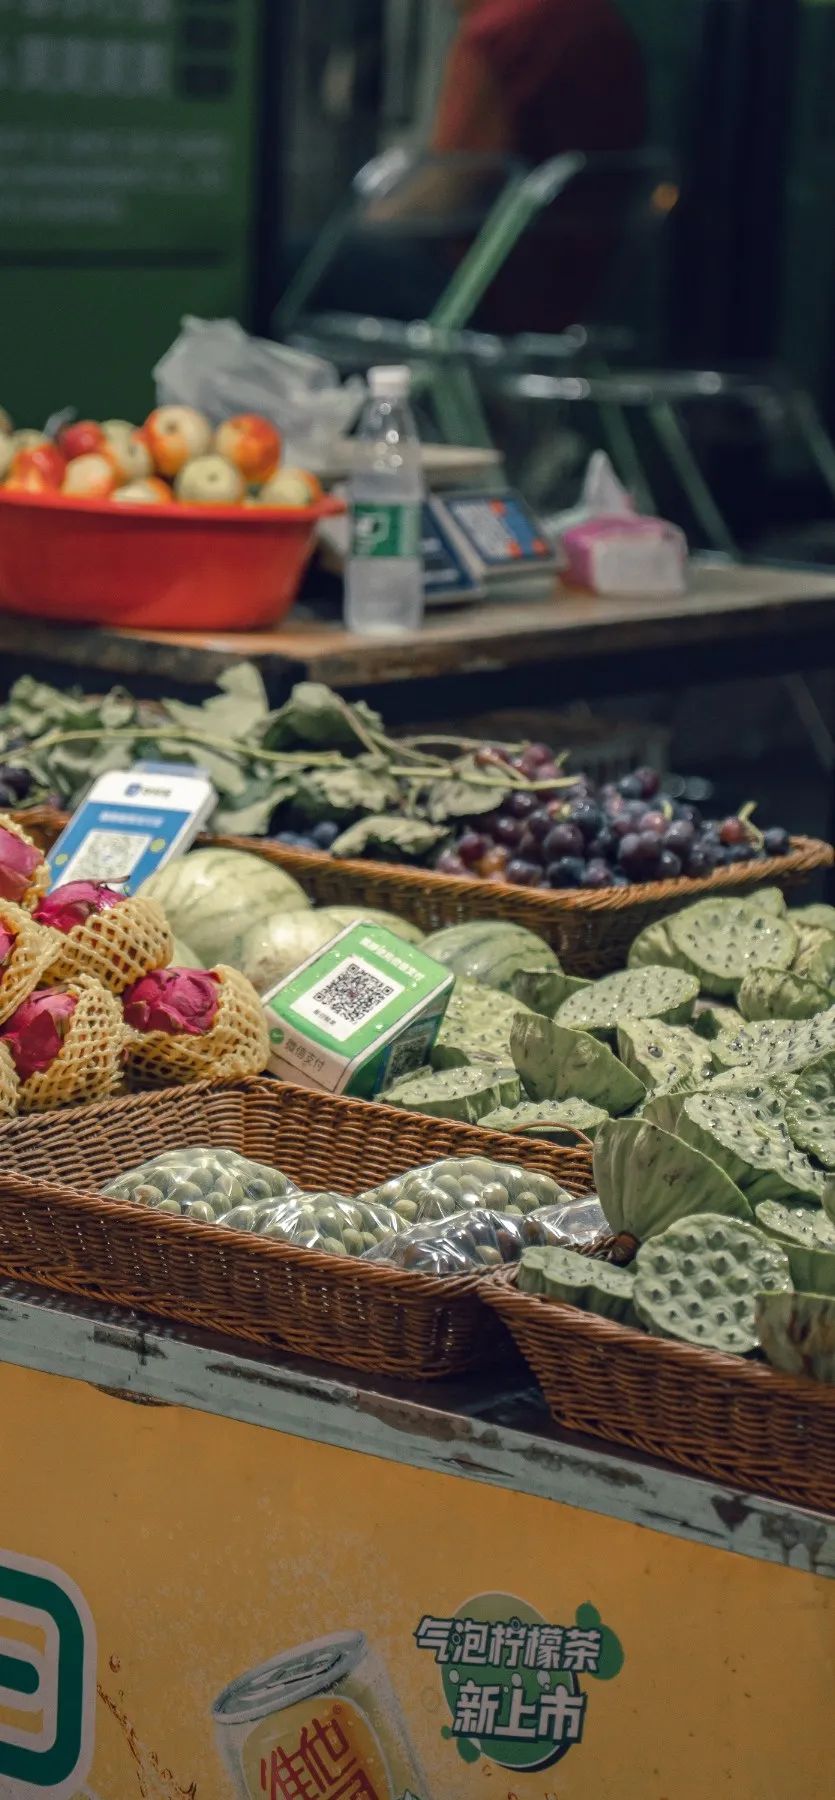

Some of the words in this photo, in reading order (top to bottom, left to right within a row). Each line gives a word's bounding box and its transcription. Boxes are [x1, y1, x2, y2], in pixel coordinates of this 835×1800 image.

[415, 1616, 602, 1673] 气泡柠檬茶
[454, 1681, 586, 1742] 新上市
